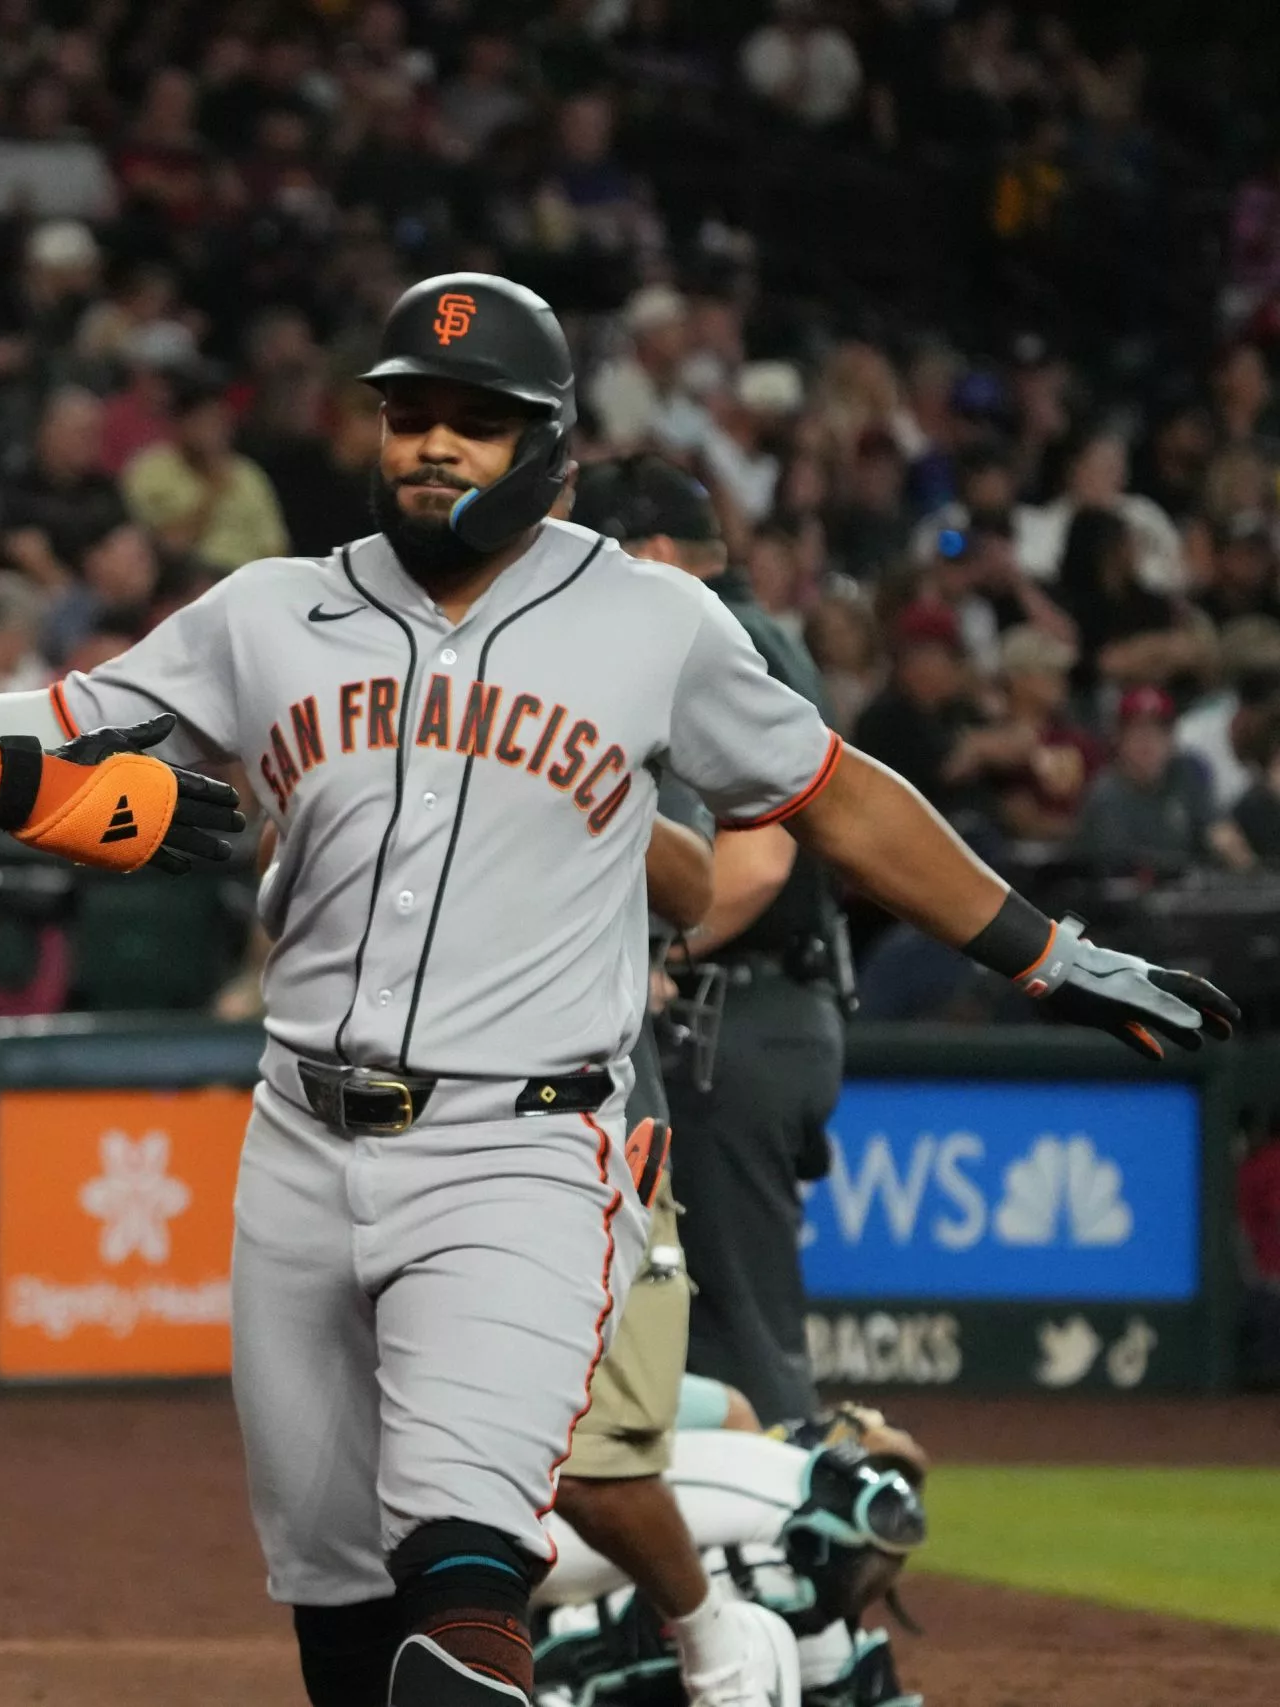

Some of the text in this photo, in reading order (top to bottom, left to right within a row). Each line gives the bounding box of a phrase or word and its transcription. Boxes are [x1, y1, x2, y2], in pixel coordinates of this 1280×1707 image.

[433, 292, 477, 346] SF
[260, 672, 633, 838] SAN FRANCISCO
[798, 1130, 988, 1250] WS
